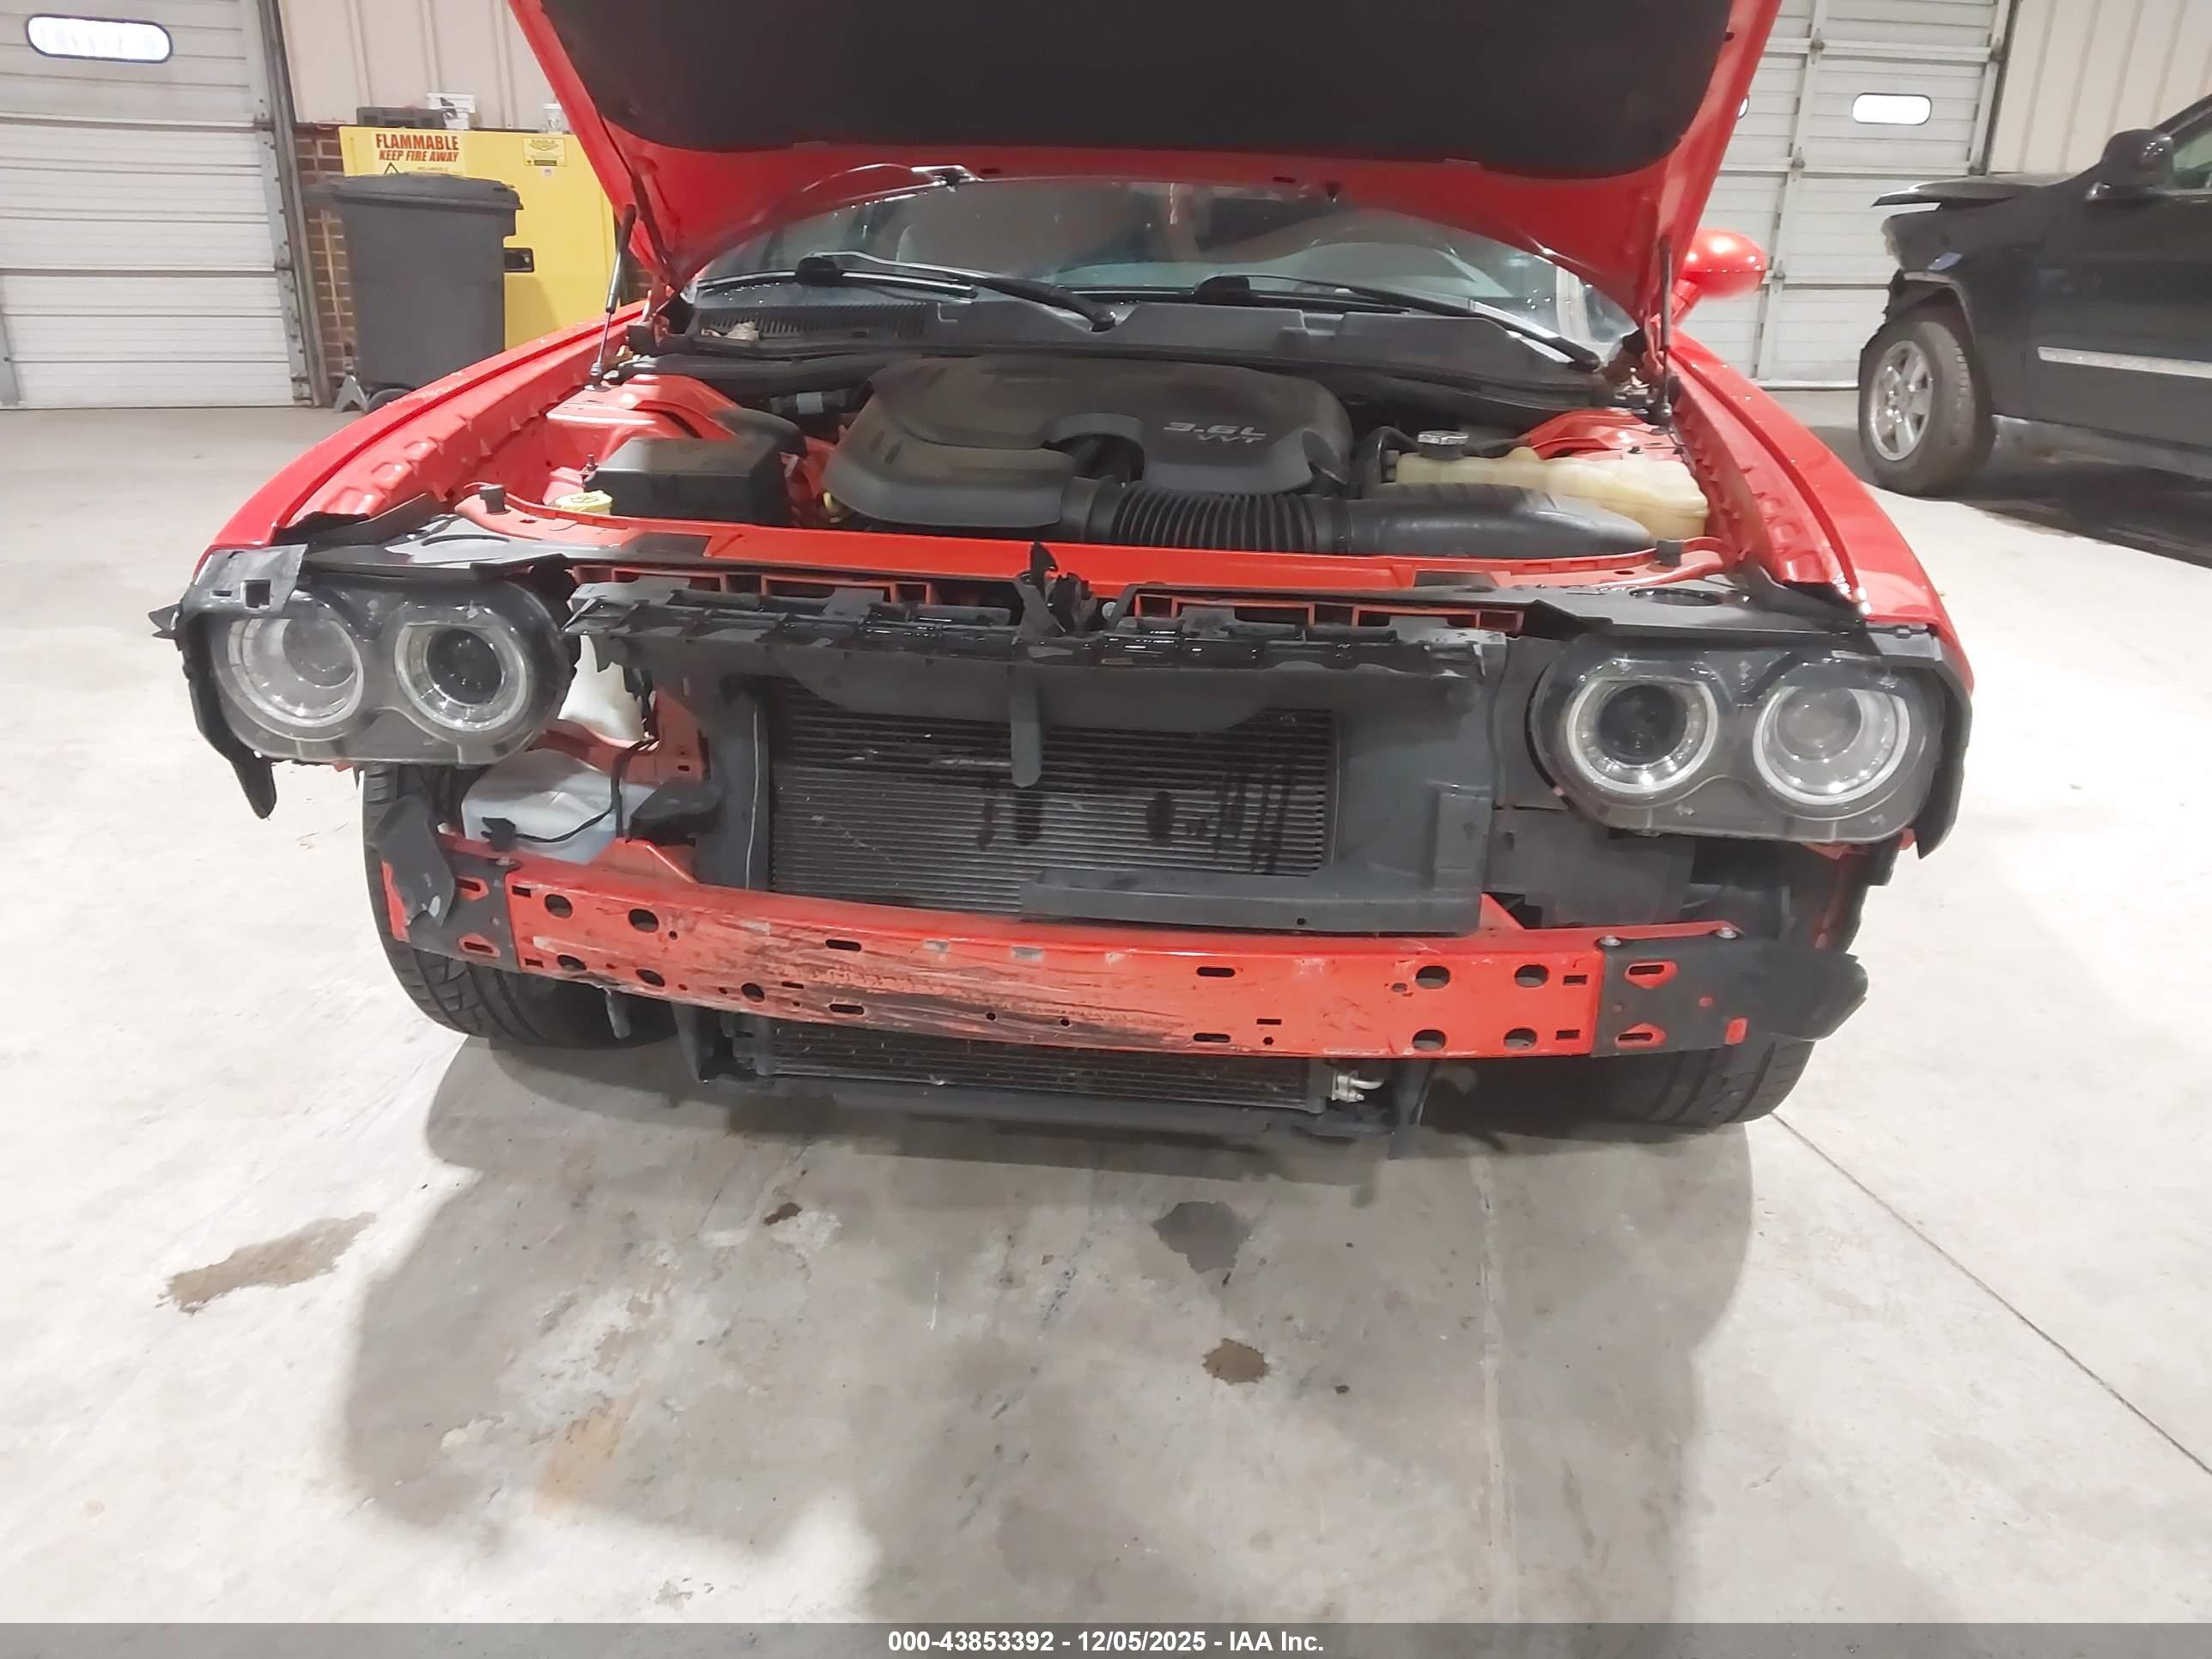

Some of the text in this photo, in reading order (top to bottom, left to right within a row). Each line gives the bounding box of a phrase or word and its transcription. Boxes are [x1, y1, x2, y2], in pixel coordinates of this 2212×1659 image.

[375, 133, 459, 150] FLAMMABLE
[379, 149, 459, 162] KEEP FIRE AWAY
[1164, 422, 1267, 435] 3.6L
[1198, 434, 1267, 443] VVT
